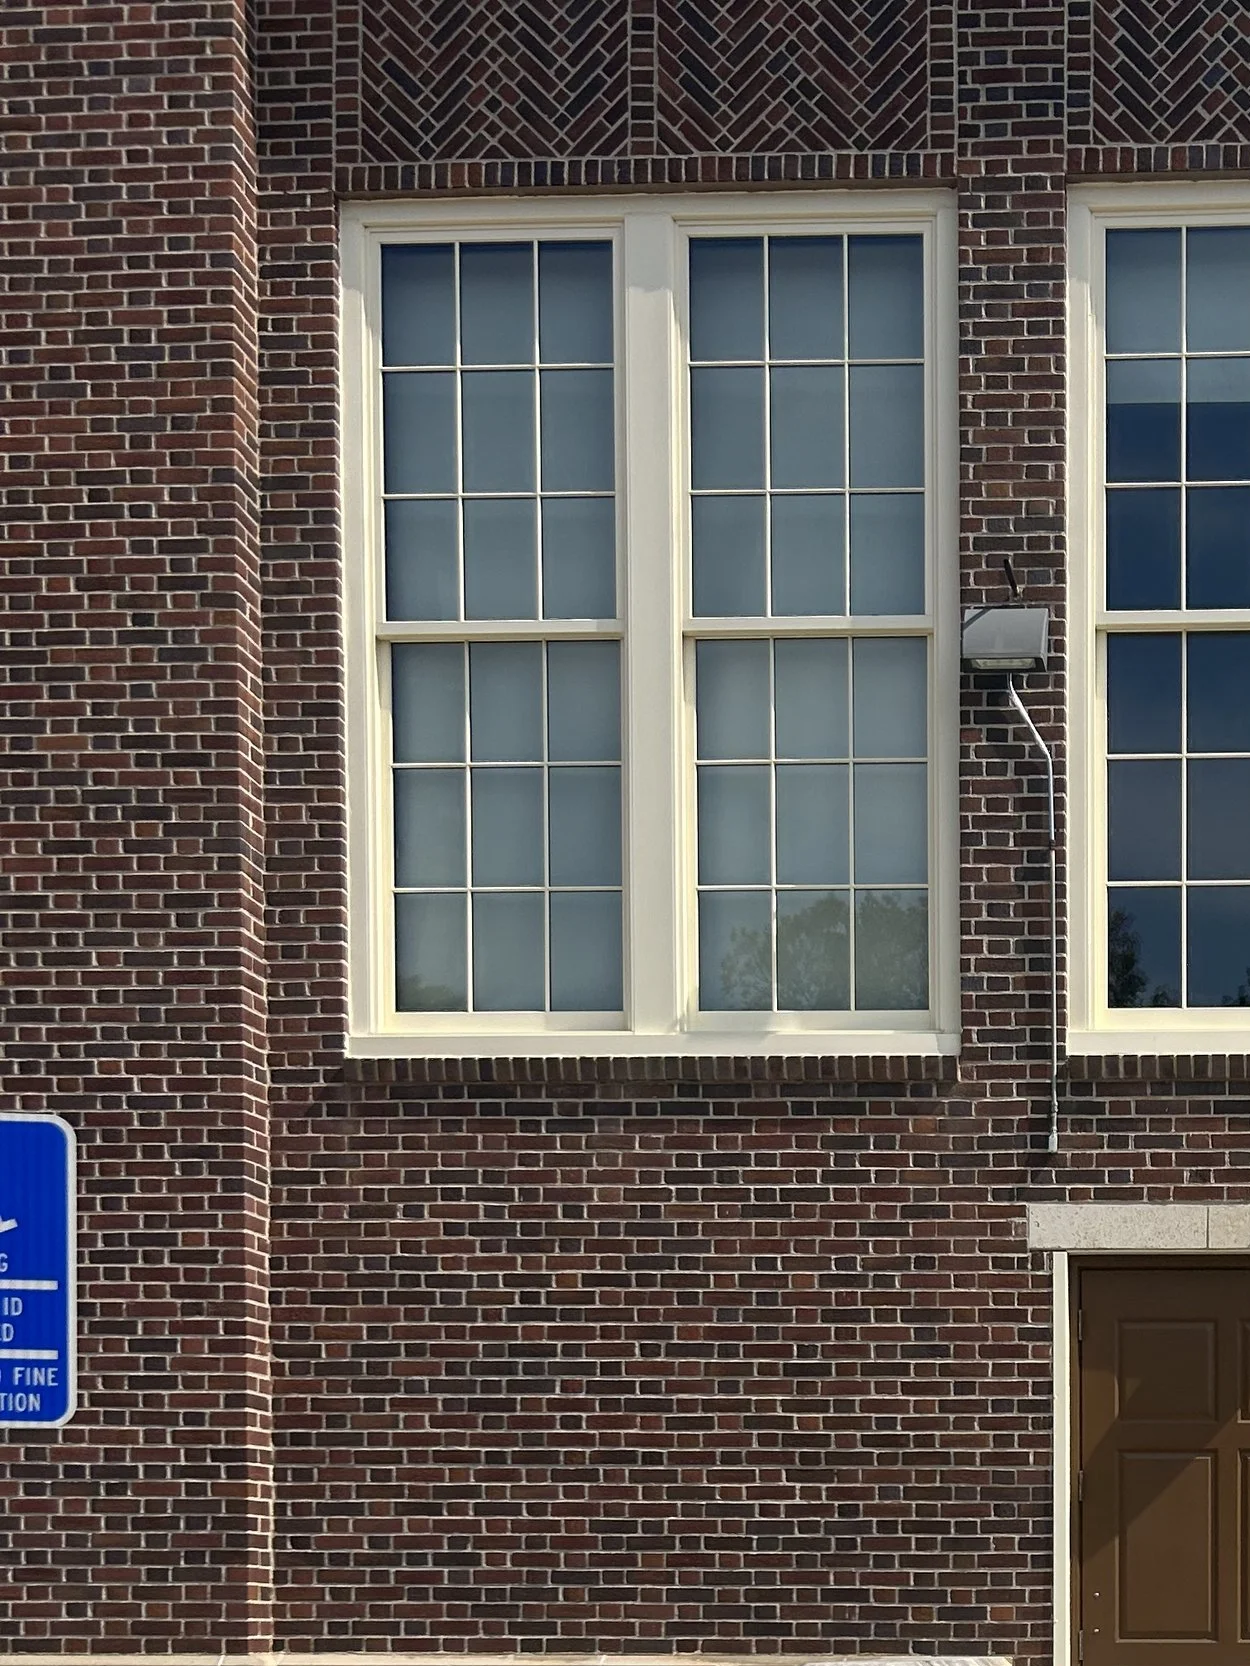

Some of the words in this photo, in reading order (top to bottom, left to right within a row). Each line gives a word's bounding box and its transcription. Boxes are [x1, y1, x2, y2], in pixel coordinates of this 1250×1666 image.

[3, 1297, 23, 1316] ID
[0, 1323, 14, 1342] D
[13, 1367, 58, 1386] FINE
[0, 1393, 41, 1412] TION
